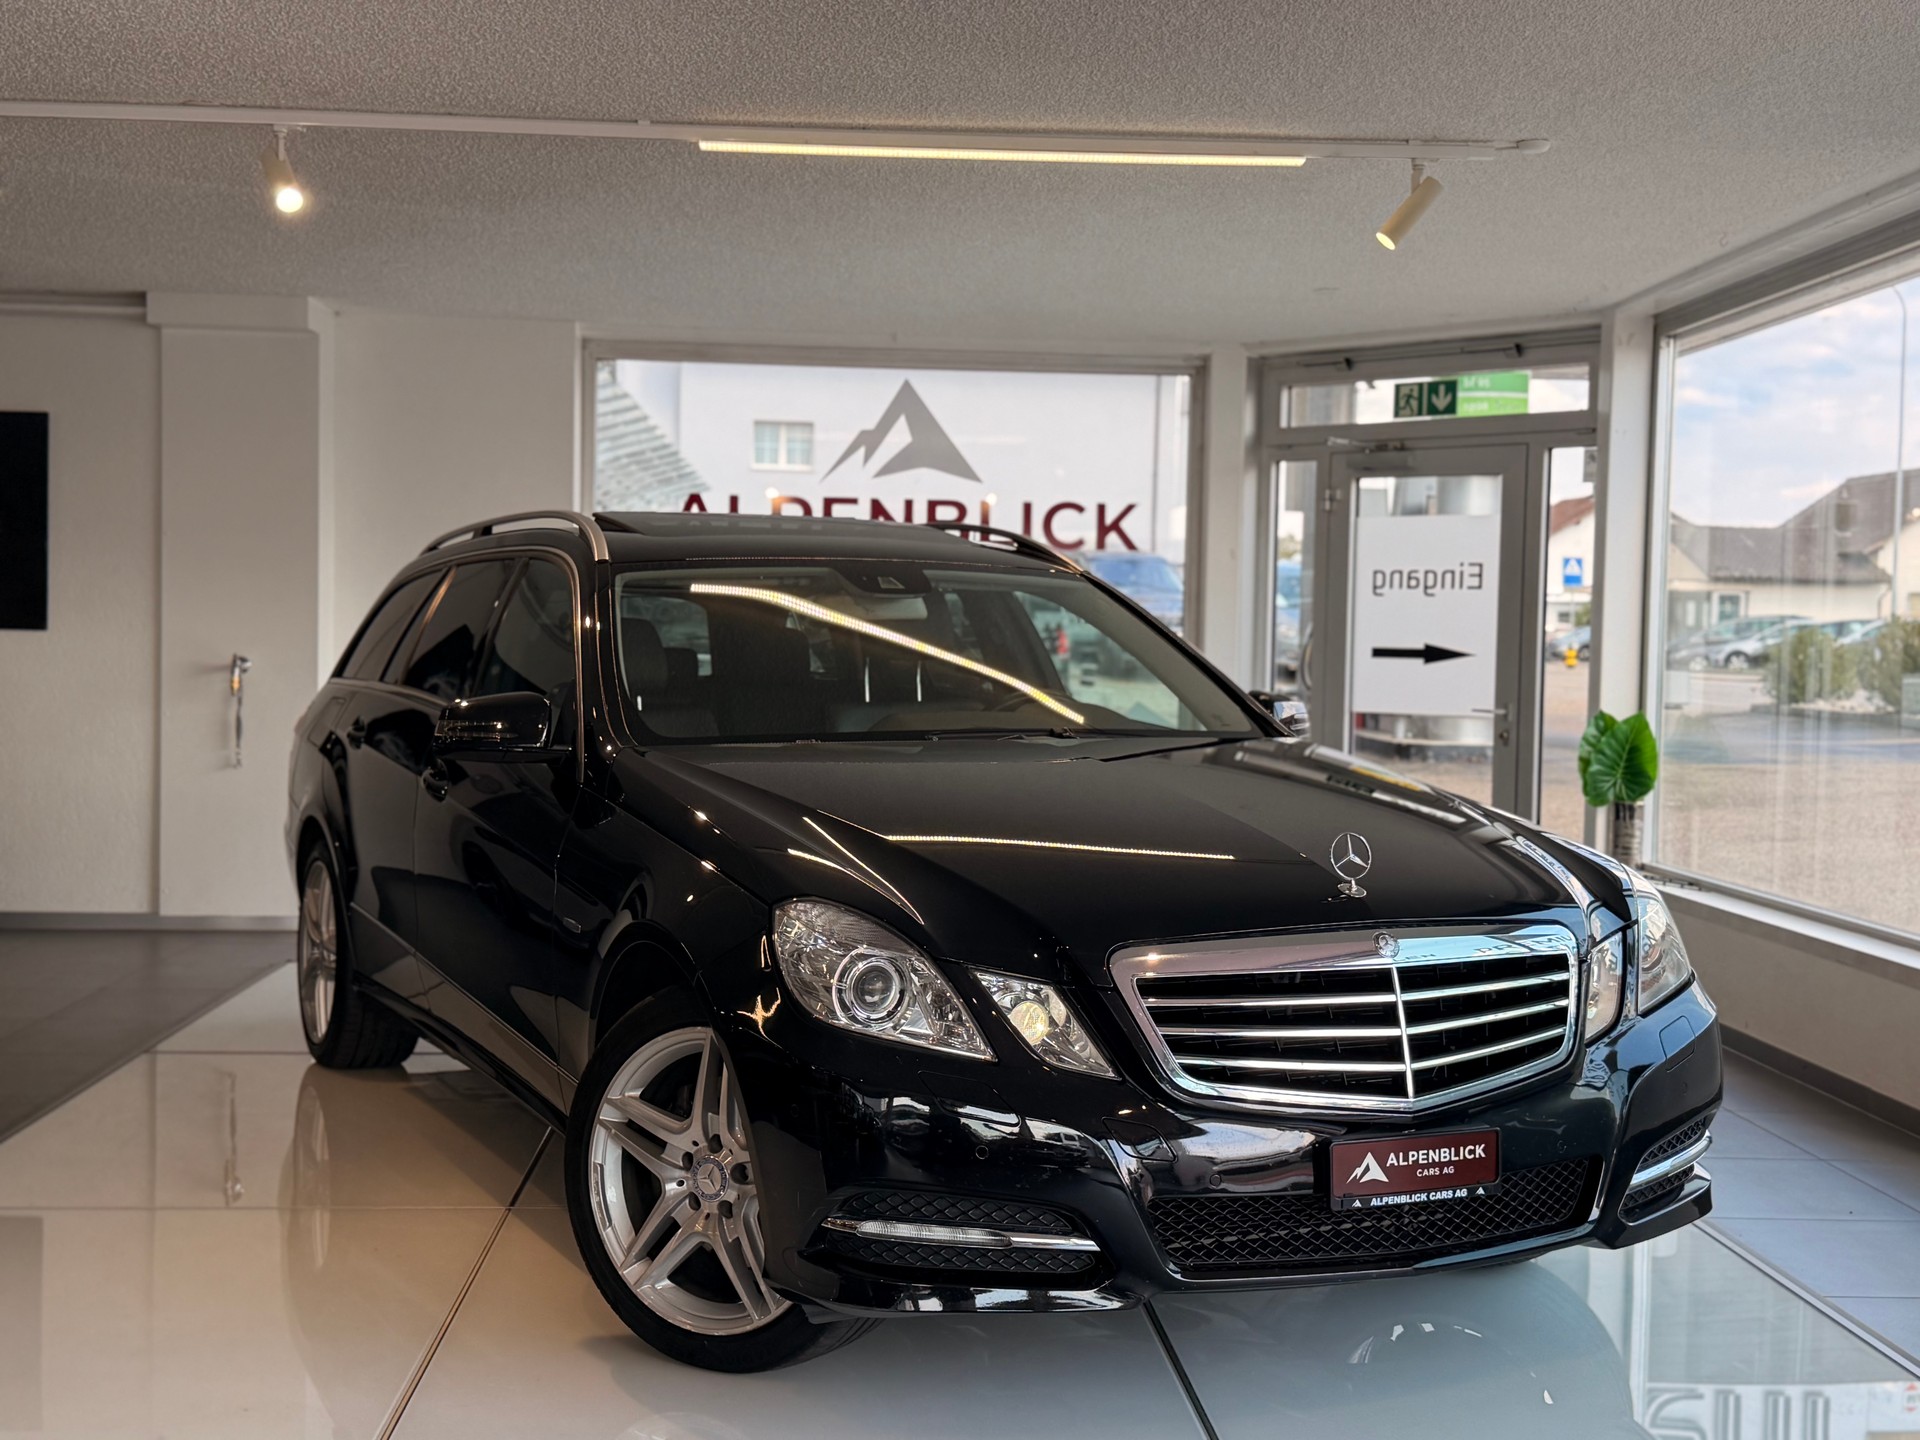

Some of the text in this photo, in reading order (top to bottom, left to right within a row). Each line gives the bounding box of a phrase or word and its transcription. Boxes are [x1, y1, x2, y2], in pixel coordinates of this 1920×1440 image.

[1386, 1144, 1486, 1167] ALPENBLICK
[1416, 1165, 1455, 1177] CARS AG
[1370, 1188, 1468, 1207] ALPENBLICK CARS AG
